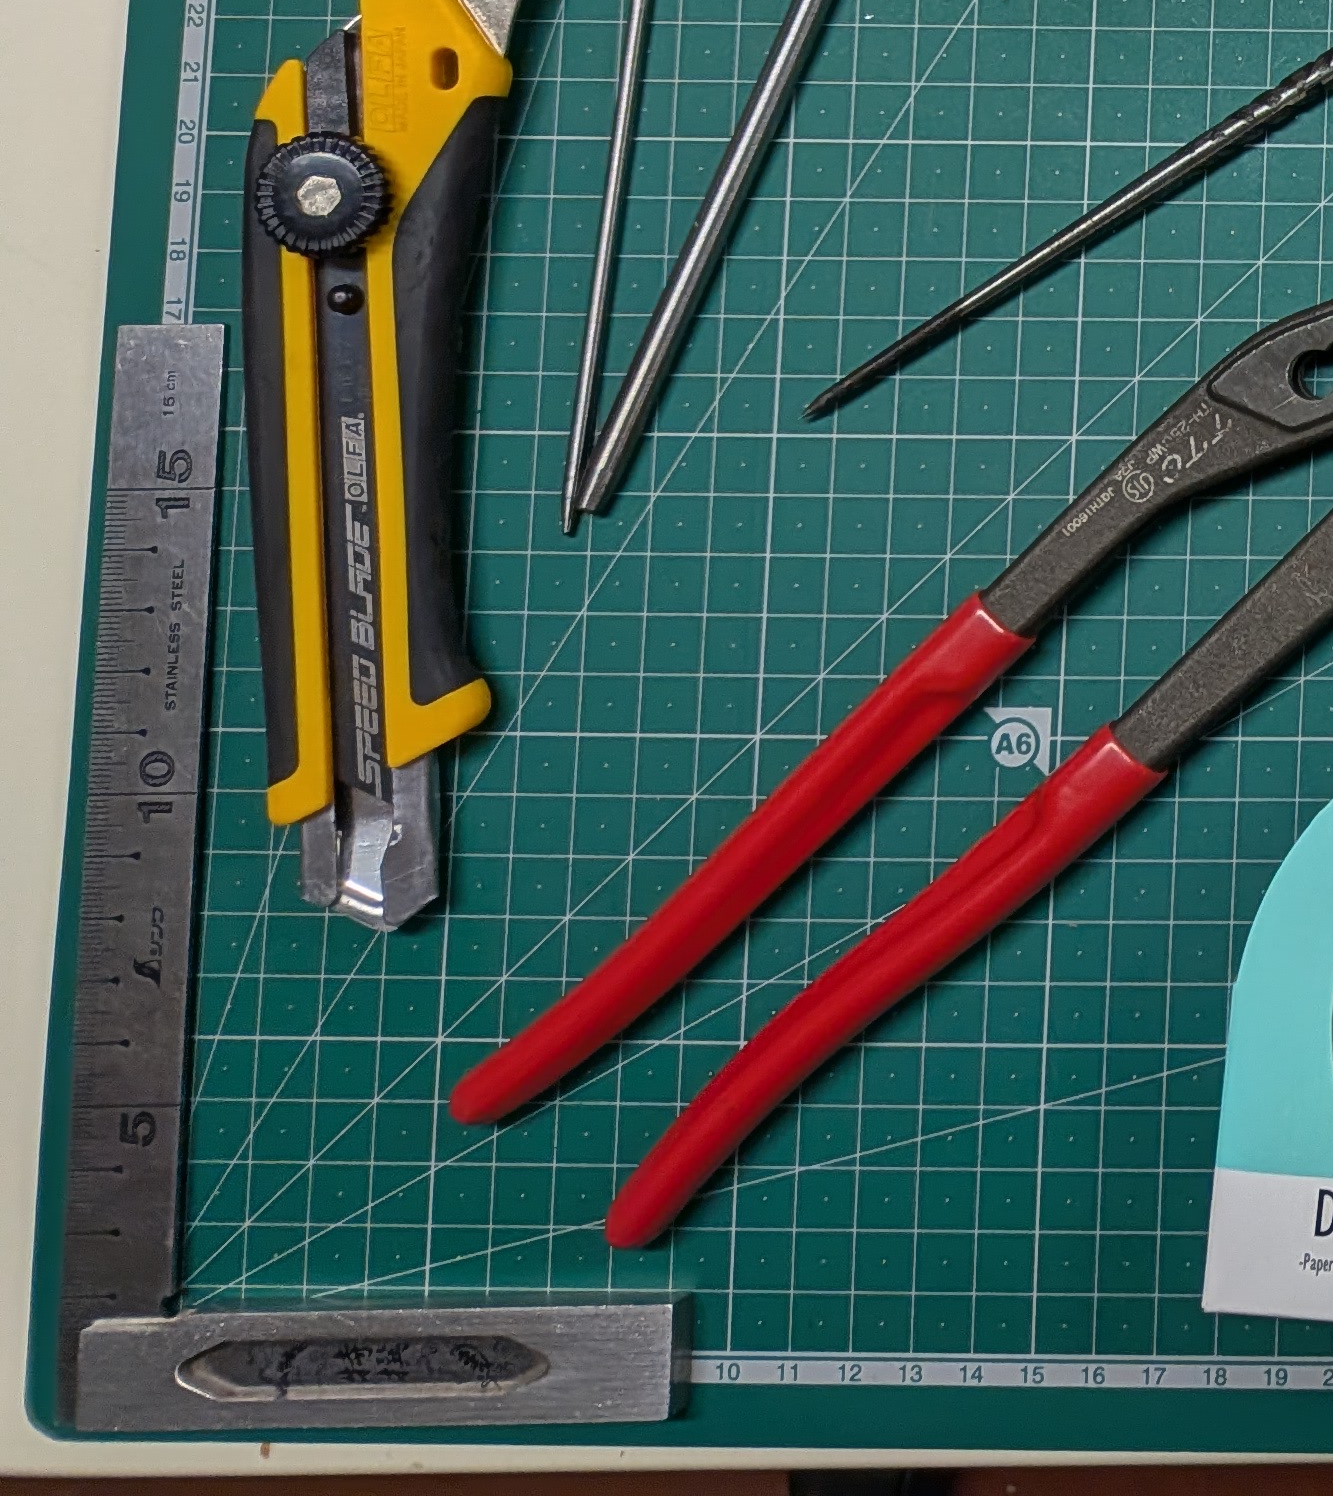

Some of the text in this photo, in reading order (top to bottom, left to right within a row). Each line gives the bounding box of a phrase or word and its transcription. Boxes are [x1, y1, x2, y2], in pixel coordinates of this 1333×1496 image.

[187, 3, 205, 28] 22
[183, 60, 201, 83] 21
[178, 119, 196, 144] 20
[173, 179, 191, 203] 19
[168, 238, 187, 262] 18
[164, 298, 182, 322] 17
[162, 370, 177, 418] 15 cm
[341, 413, 368, 503] OLFA
[156, 448, 193, 520] 15
[164, 559, 186, 711] STAINLESS STEEL
[346, 504, 382, 804] SPEED BLADE
[995, 733, 1031, 755] A6
[137, 750, 176, 824] 10
[118, 1112, 156, 1148] 5
[716, 1363, 740, 1381] 10
[777, 1364, 799, 1382] 11
[838, 1364, 862, 1382] 12
[899, 1364, 923, 1383] 13
[959, 1364, 984, 1383] 14
[1020, 1365, 1045, 1384] 15
[1081, 1366, 1106, 1384] 16
[1142, 1366, 1166, 1385] 17
[1203, 1367, 1227, 1386] 18
[1264, 1367, 1288, 1386] 19
